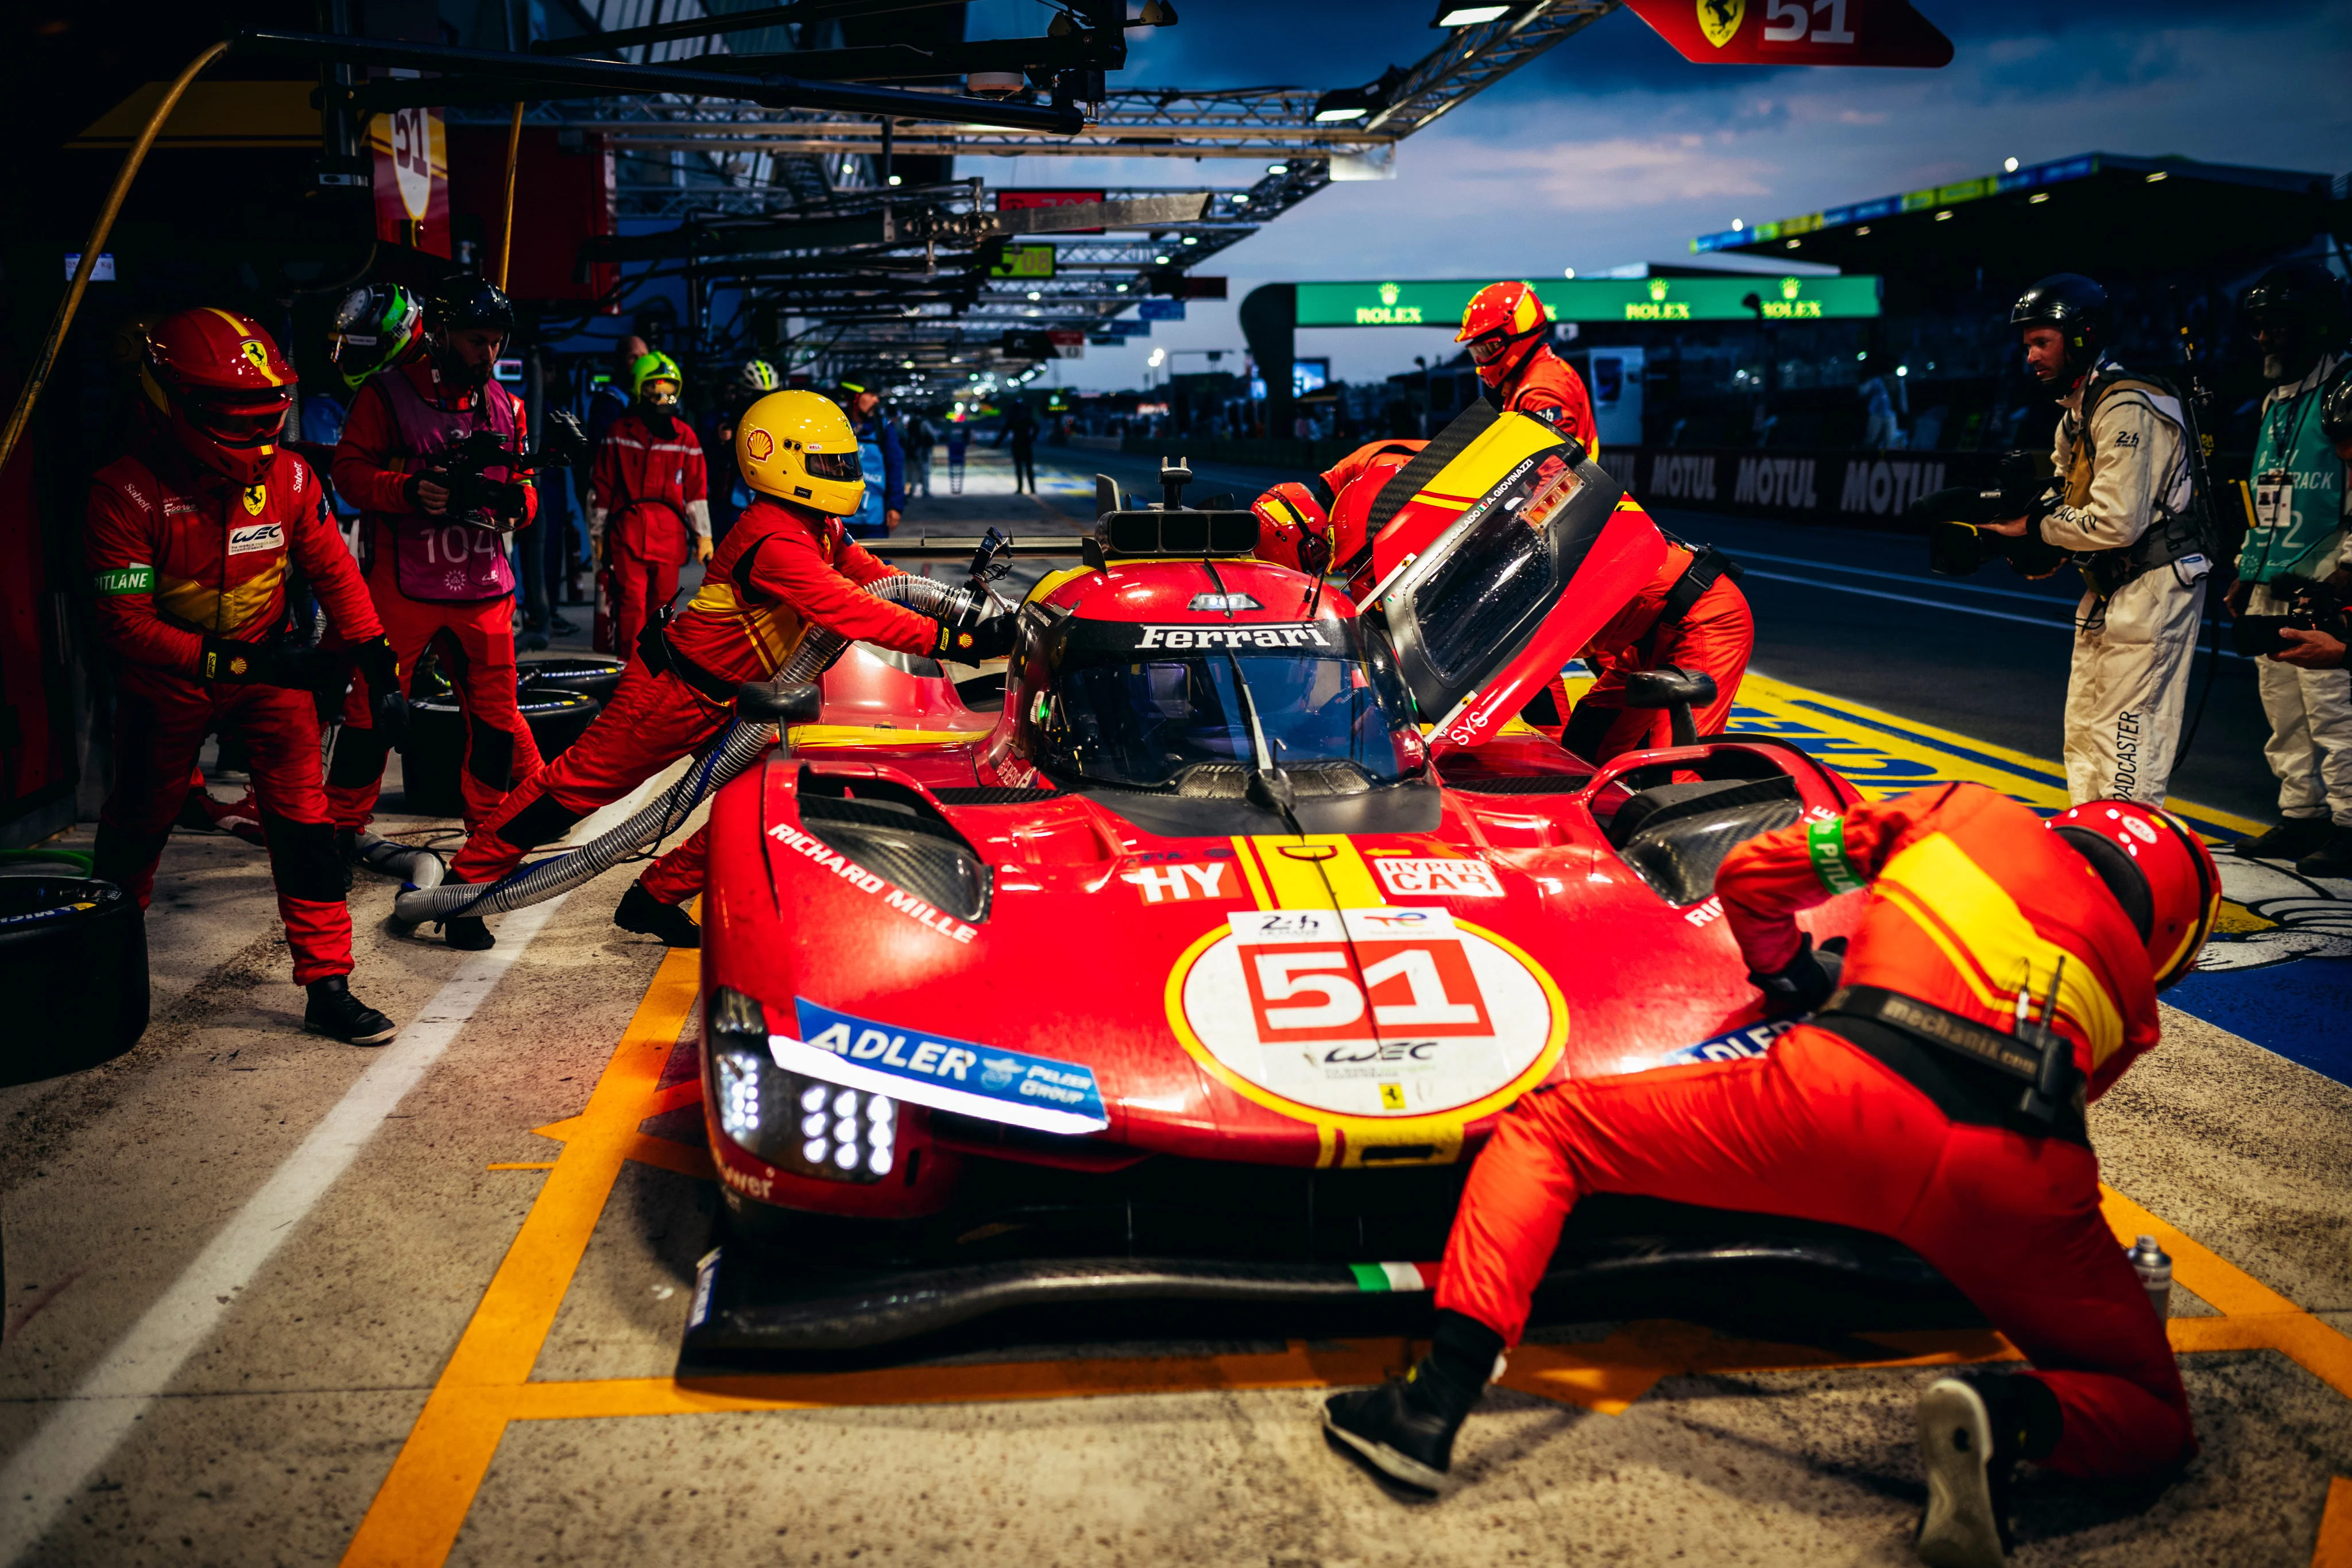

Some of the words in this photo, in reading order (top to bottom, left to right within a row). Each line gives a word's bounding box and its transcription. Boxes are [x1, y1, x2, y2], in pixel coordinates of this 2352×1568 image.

[1764, 0, 1855, 43] 51
[394, 111, 428, 178] 51
[1356, 307, 1422, 323] ROLEX
[1626, 303, 1689, 320] ROLEX
[1761, 301, 1823, 318] ROLEX
[293, 461, 303, 494] Sabelt
[1487, 497, 1497, 506] A.
[1493, 458, 1534, 498] GIOVINAZZI
[1650, 454, 1716, 501] MOTUL
[1734, 456, 1817, 509] MOTUL
[2287, 472, 2335, 490] RACK
[124, 483, 152, 513] Sabelt
[1450, 510, 1481, 540] CALADO
[2053, 506, 2077, 522] AC
[231, 525, 281, 544] WEC
[420, 525, 496, 564] 104
[94, 573, 148, 592] PITLANE
[941, 629, 949, 650] Sabelt
[1135, 624, 1331, 649] Ferrari
[208, 654, 216, 677] Sabelt
[1450, 711, 1488, 746] SYS
[1383, 862, 1483, 873] HYPER
[767, 823, 885, 895] RICHARD
[884, 889, 978, 944] MILLE
[1139, 862, 1225, 903] HY
[1391, 873, 1495, 892] CAR
[1254, 948, 1480, 1030] 51
[806, 1022, 977, 1081] ADLER
[1325, 1042, 1438, 1063] WEC
[1027, 1065, 1092, 1091] PELZER
[1019, 1080, 1085, 1105] GROUP
